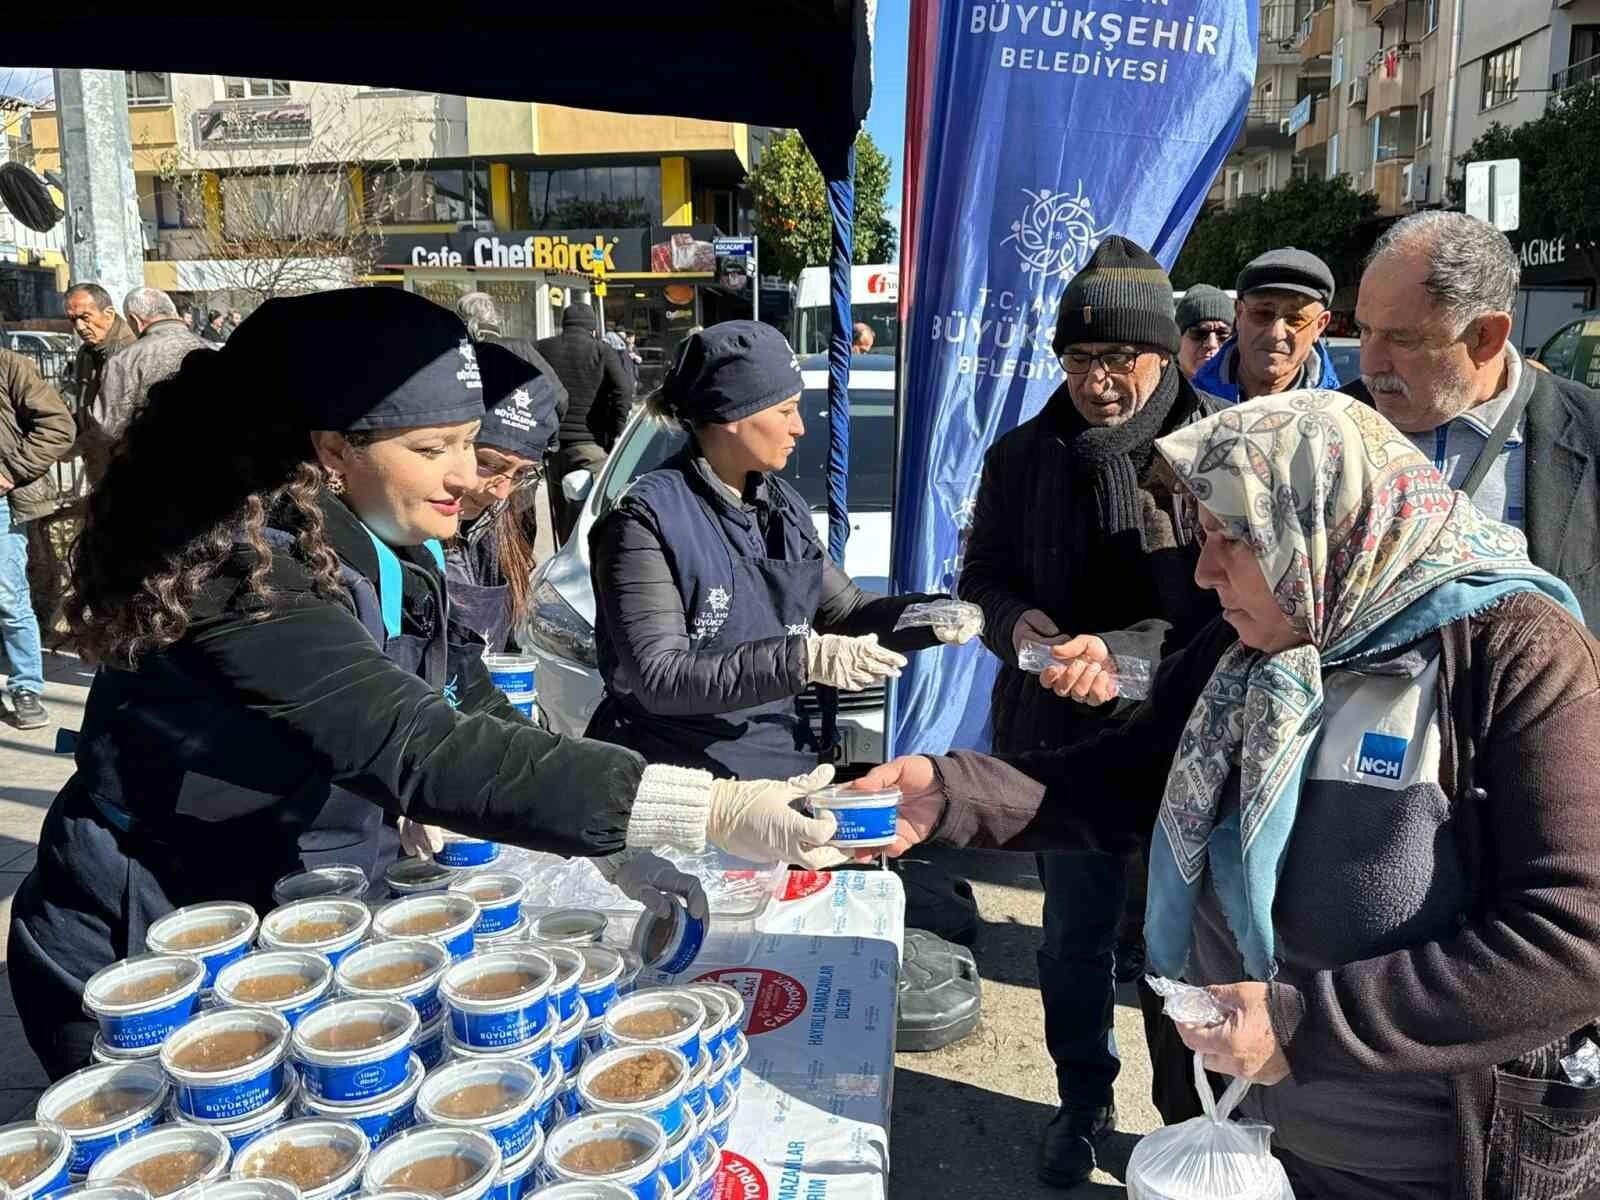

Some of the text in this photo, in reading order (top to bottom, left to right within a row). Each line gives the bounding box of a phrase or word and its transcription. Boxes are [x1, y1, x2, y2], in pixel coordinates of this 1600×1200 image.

[970, 2, 1218, 55] BÜYÜKŞEHİR
[1000, 47, 1169, 84] BELEDİYESİ
[412, 235, 616, 271] Cafe ChefBörek
[979, 288, 1062, 315] T.C. AY
[931, 311, 1056, 356] BÜYÜKŞ
[958, 355, 1068, 380] BELEDİY
[1359, 756, 1400, 777] NCH
[814, 965, 834, 1012] RAMAZANLAR
[835, 988, 852, 1020] DİLERİM
[808, 1012, 826, 1046] HAYIRLI
[725, 1160, 761, 1200] YORUZ
[778, 1141, 805, 1200] MAZANLAR
[806, 1179, 828, 1200] RİM
